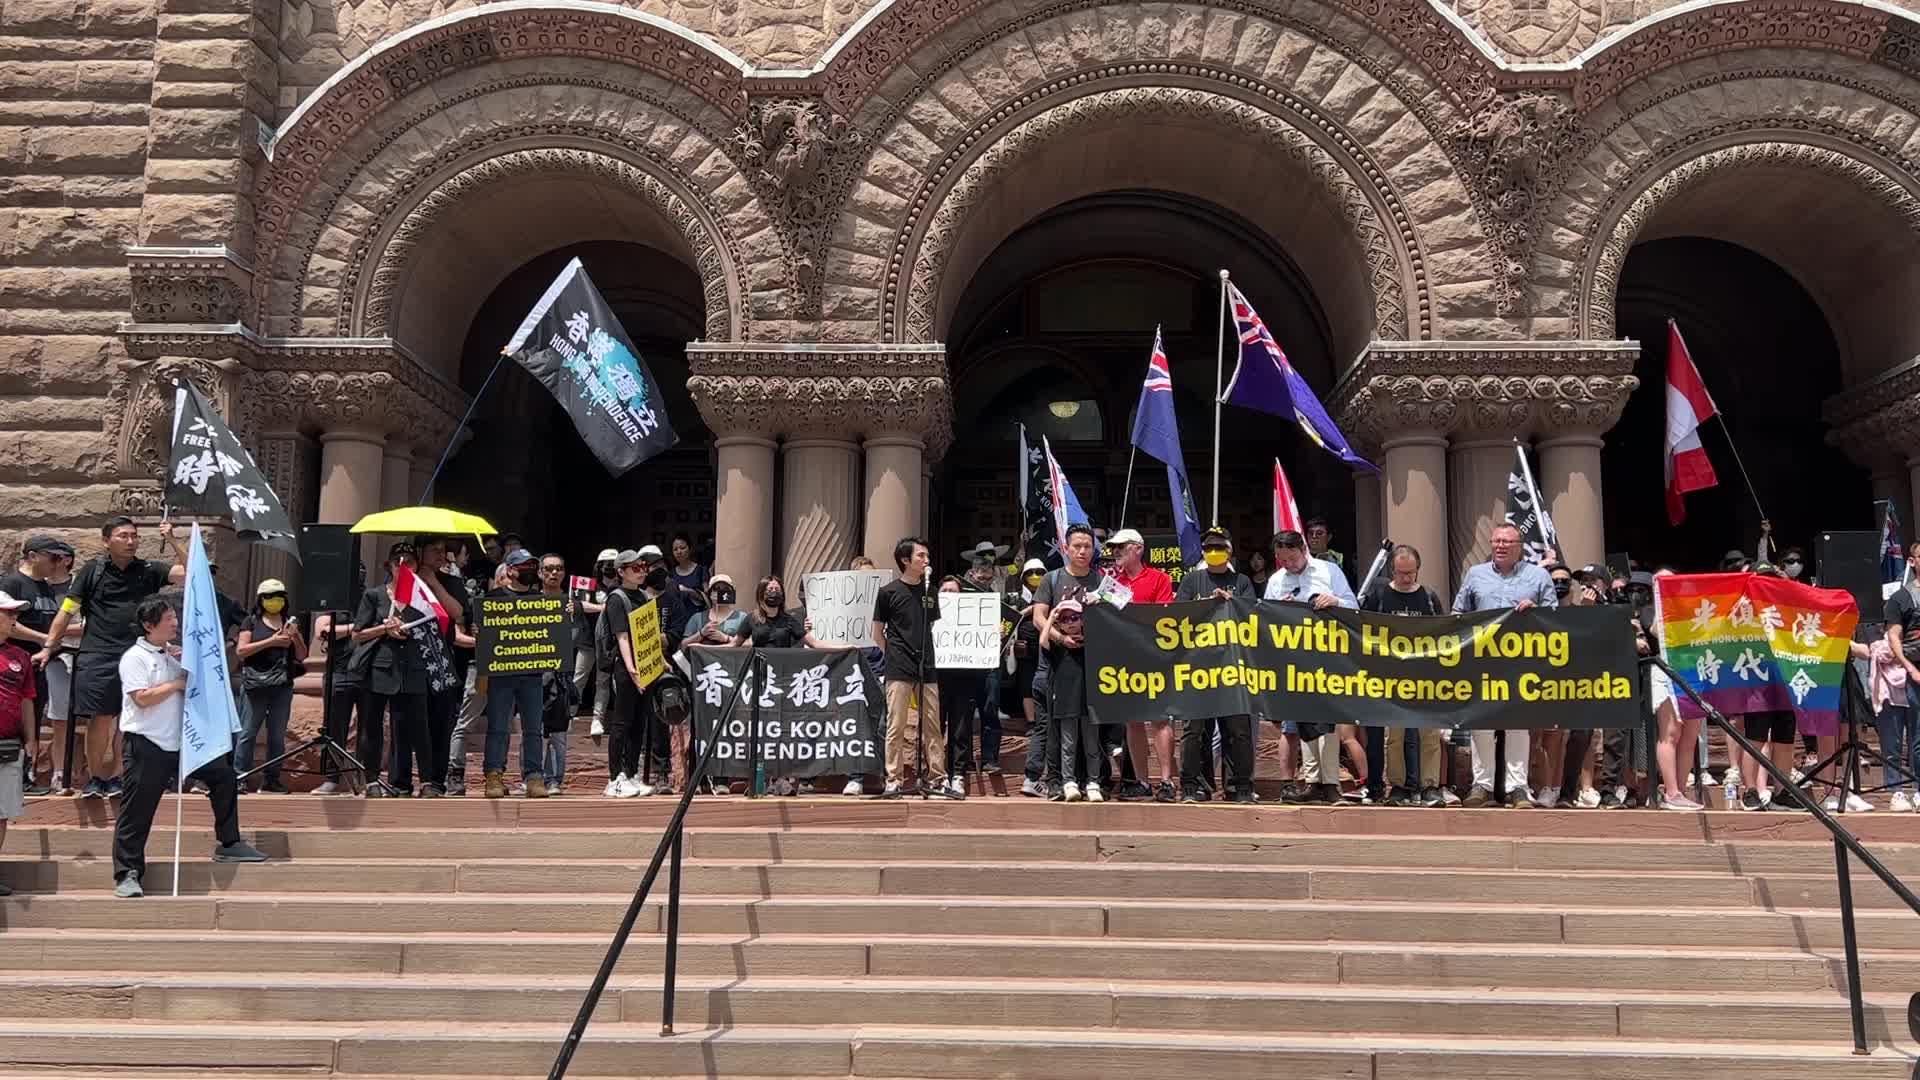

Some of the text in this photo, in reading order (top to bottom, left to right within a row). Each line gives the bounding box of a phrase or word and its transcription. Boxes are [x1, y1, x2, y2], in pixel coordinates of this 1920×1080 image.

[549, 333, 577, 361] HONG
[585, 371, 643, 444] INDEPENDENCE
[183, 433, 212, 449] FREE
[483, 599, 561, 612] Stop foreign
[483, 614, 562, 626] interference
[500, 628, 549, 640] Protect
[1156, 614, 1569, 667] Stand with Hong Kong
[1712, 633, 1738, 644] HONG
[494, 643, 555, 656] Canadian
[489, 658, 562, 672] democracy
[696, 661, 869, 708] 香港獨立
[1099, 660, 1631, 700] Stop Foreign Interference in Canada
[791, 717, 857, 739] KONG
